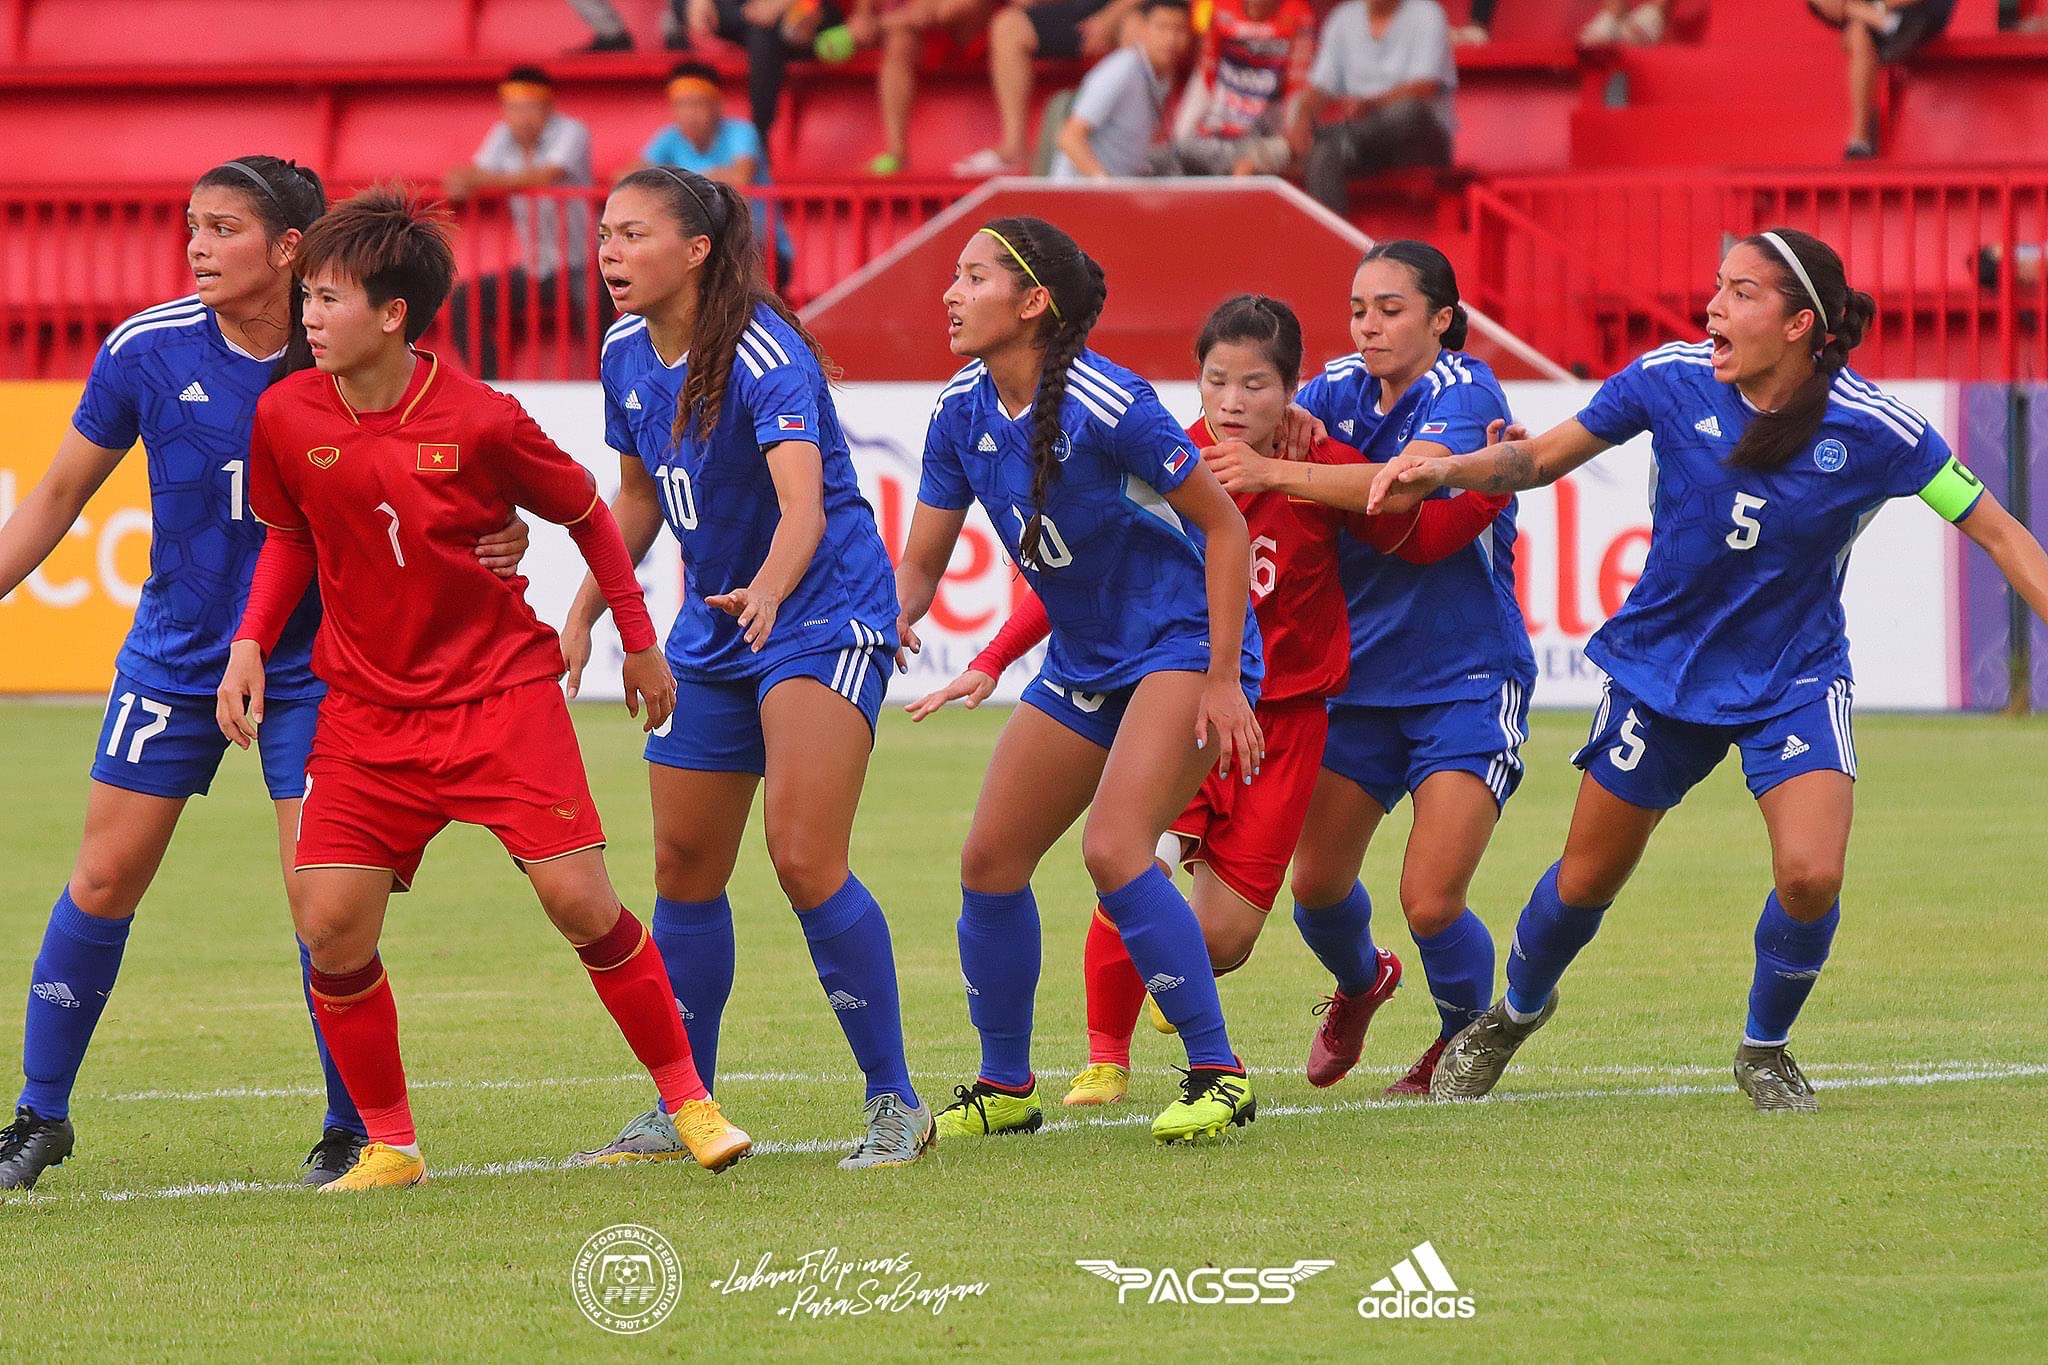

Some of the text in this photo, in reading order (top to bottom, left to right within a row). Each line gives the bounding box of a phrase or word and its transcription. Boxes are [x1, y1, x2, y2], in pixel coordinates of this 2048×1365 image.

[655, 464, 699, 531] 10
[1725, 491, 1768, 550] 5
[1249, 534, 1277, 598] 6
[106, 691, 173, 764] 17
[1609, 707, 1647, 772] 5
[1780, 743, 1811, 761] adidas
